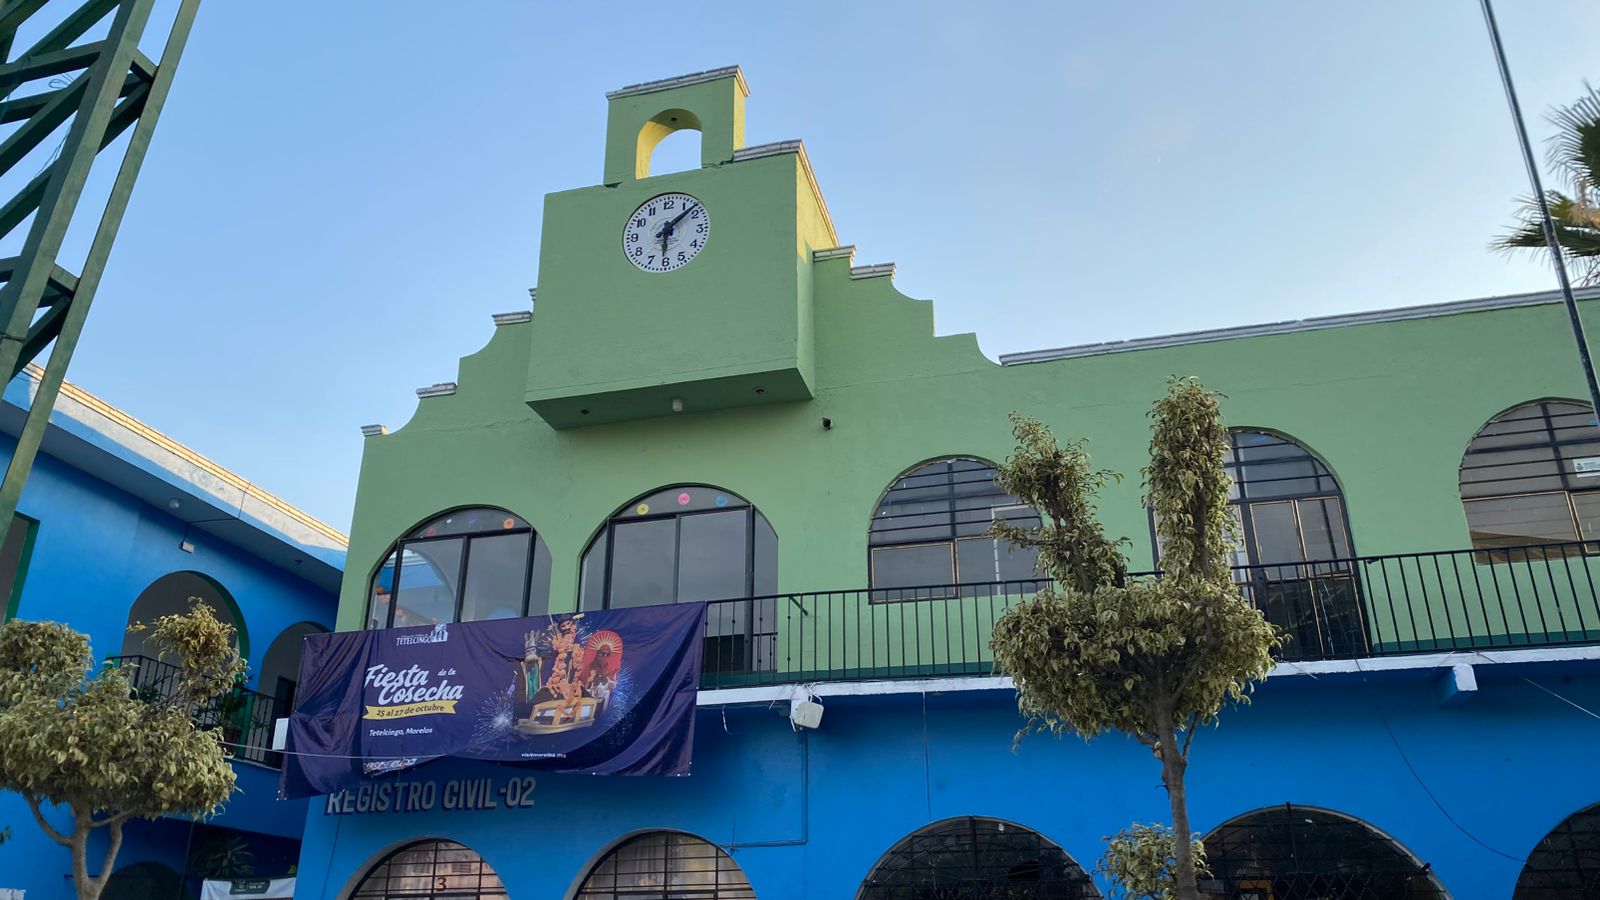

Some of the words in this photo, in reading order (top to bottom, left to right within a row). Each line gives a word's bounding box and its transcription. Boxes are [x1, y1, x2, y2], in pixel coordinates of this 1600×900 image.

[663, 200, 674, 210] 12
[681, 202, 686, 211] 1
[648, 207, 656, 216] 11
[691, 210, 699, 219] 2
[636, 218, 646, 228] 10
[696, 224, 703, 233] 3
[630, 233, 638, 242] 9
[689, 239, 697, 248] 4
[635, 247, 642, 256] 8
[647, 255, 655, 265] 7
[677, 252, 685, 261] 5
[662, 257, 669, 267] 6
[364, 664, 429, 688] Fiesta
[378, 680, 464, 705] Cosecha
[415, 703, 445, 712] octubre
[405, 727, 433, 735] Morelos
[326, 780, 436, 814] REGISTRO
[435, 877, 447, 892] 3
